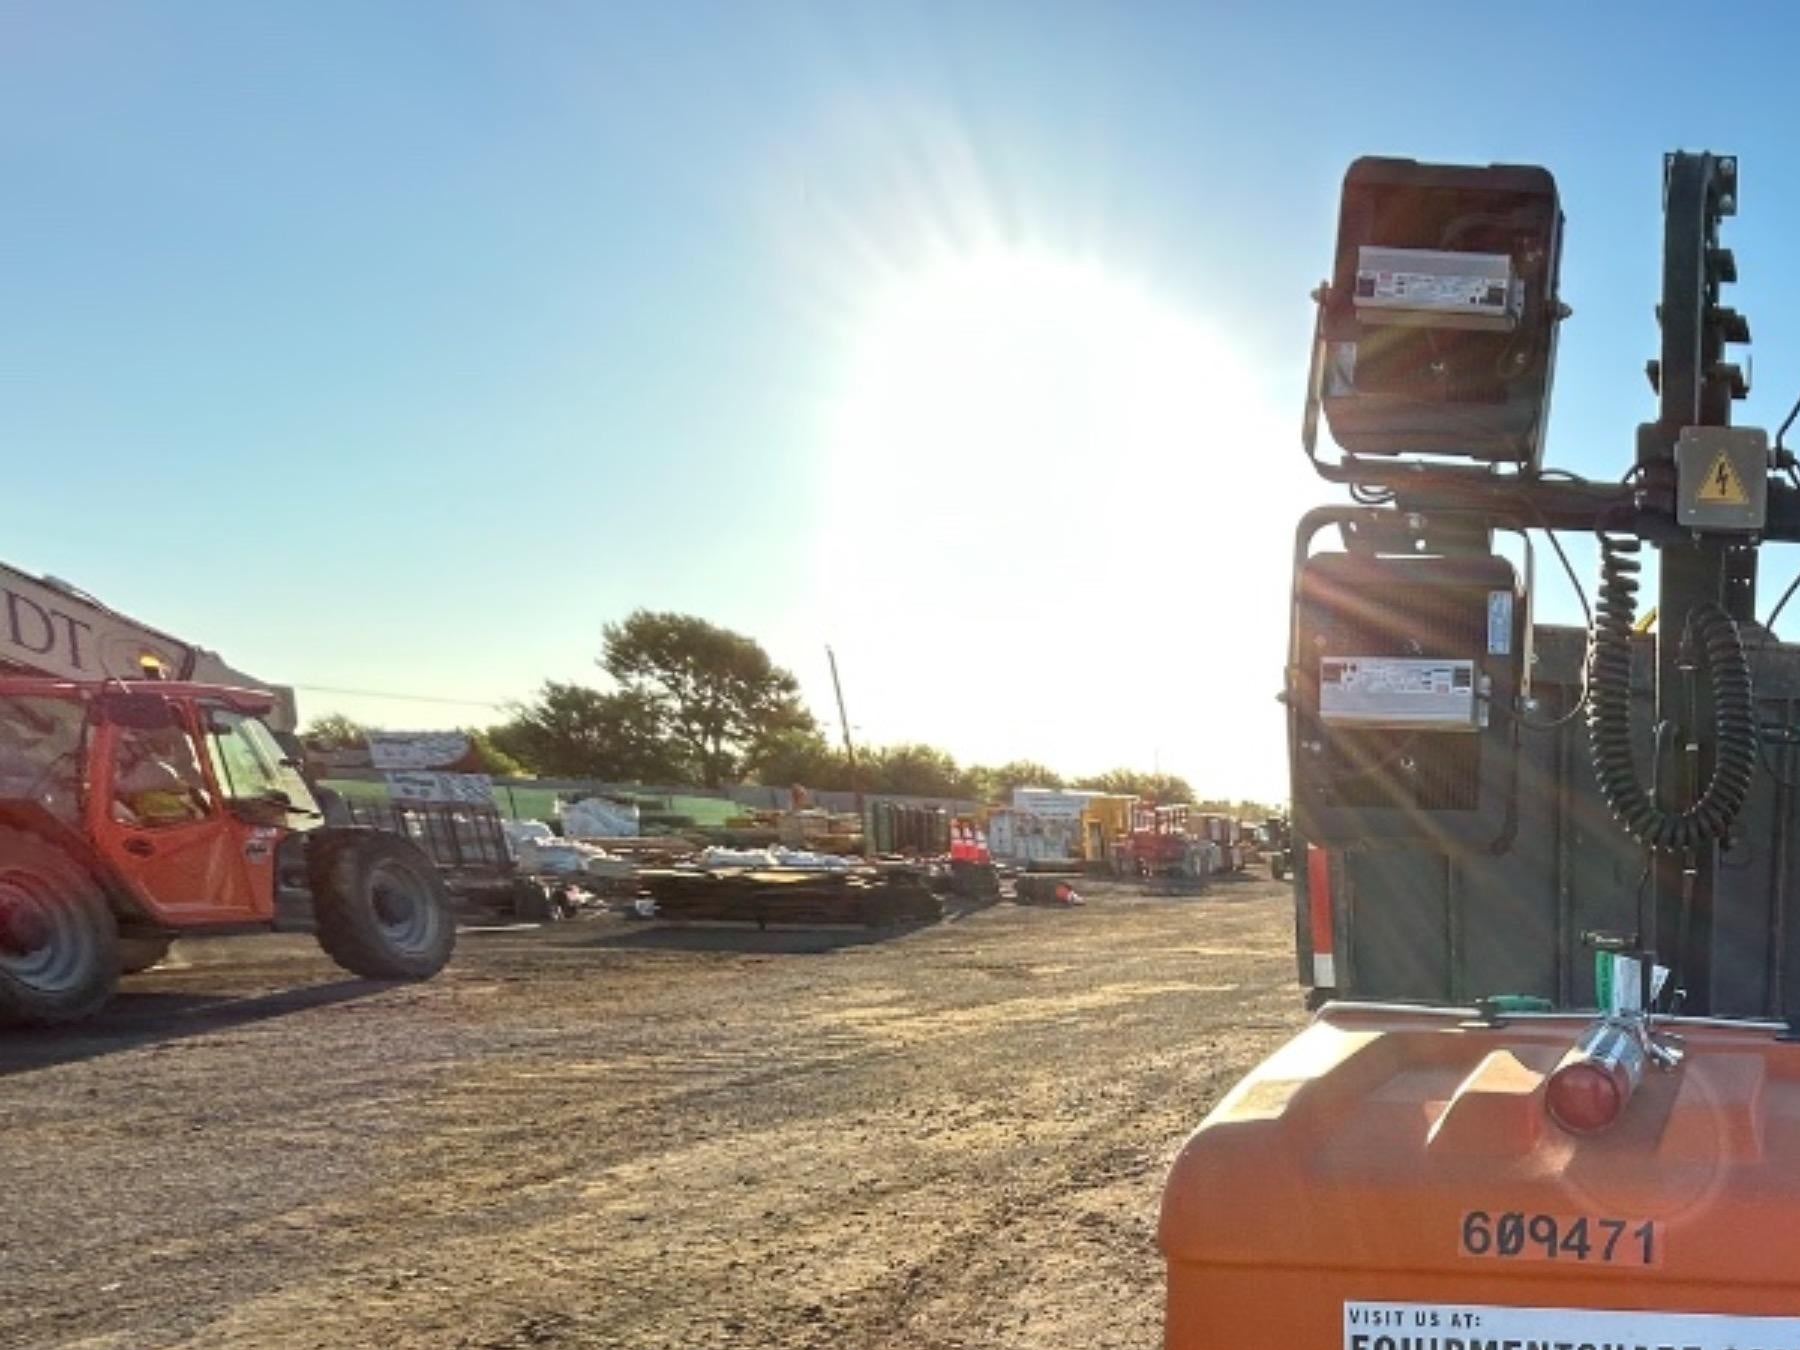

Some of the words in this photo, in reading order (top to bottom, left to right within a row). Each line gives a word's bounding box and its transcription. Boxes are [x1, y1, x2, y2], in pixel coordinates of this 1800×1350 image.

[1463, 1211, 1654, 1264] 609471
[1349, 1308, 1404, 1327] VISIT
[1415, 1311, 1440, 1327] US
[1451, 1313, 1481, 1329] AT:
